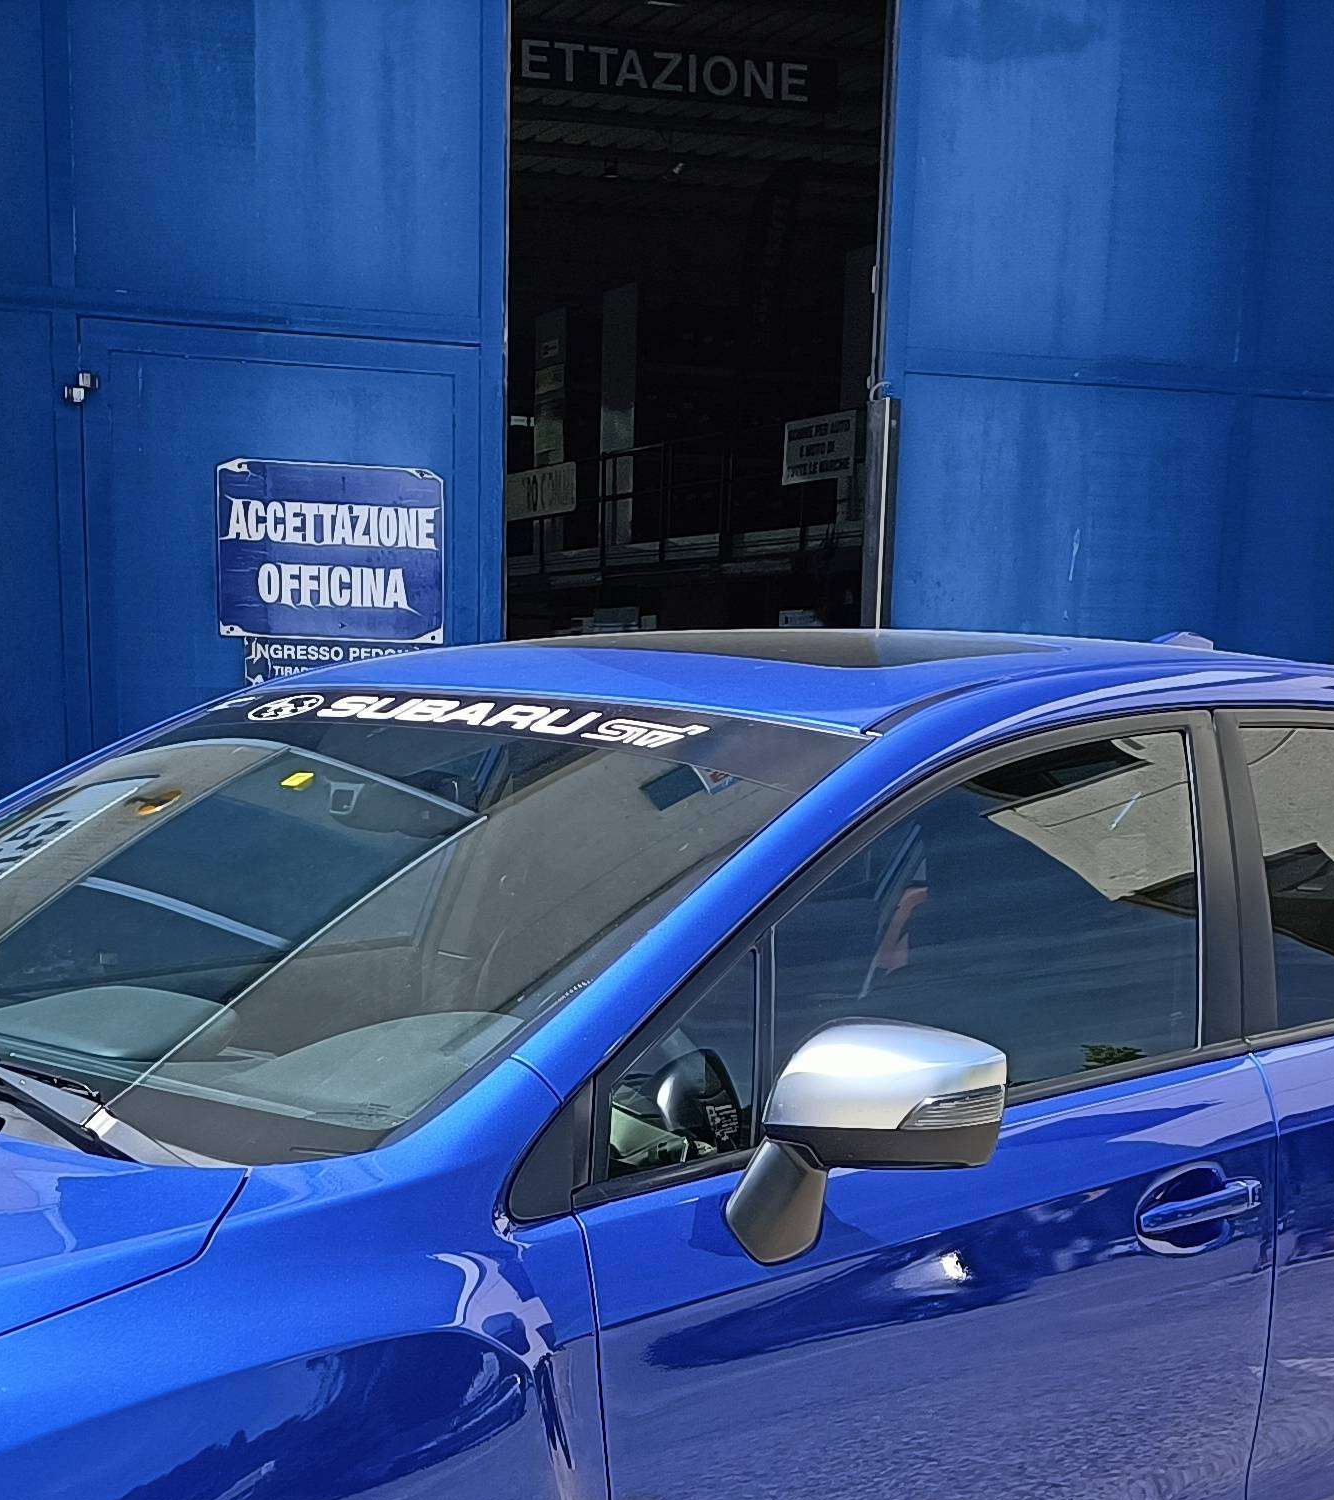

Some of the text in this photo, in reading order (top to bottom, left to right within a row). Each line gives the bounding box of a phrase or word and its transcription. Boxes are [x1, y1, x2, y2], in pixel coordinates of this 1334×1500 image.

[520, 38, 808, 102] ETTAZIONE
[228, 498, 438, 549] ACCETTAZIONE
[258, 563, 409, 609] OFFICINA
[250, 642, 345, 661] INGRESSO
[317, 695, 603, 734] SUBARU
